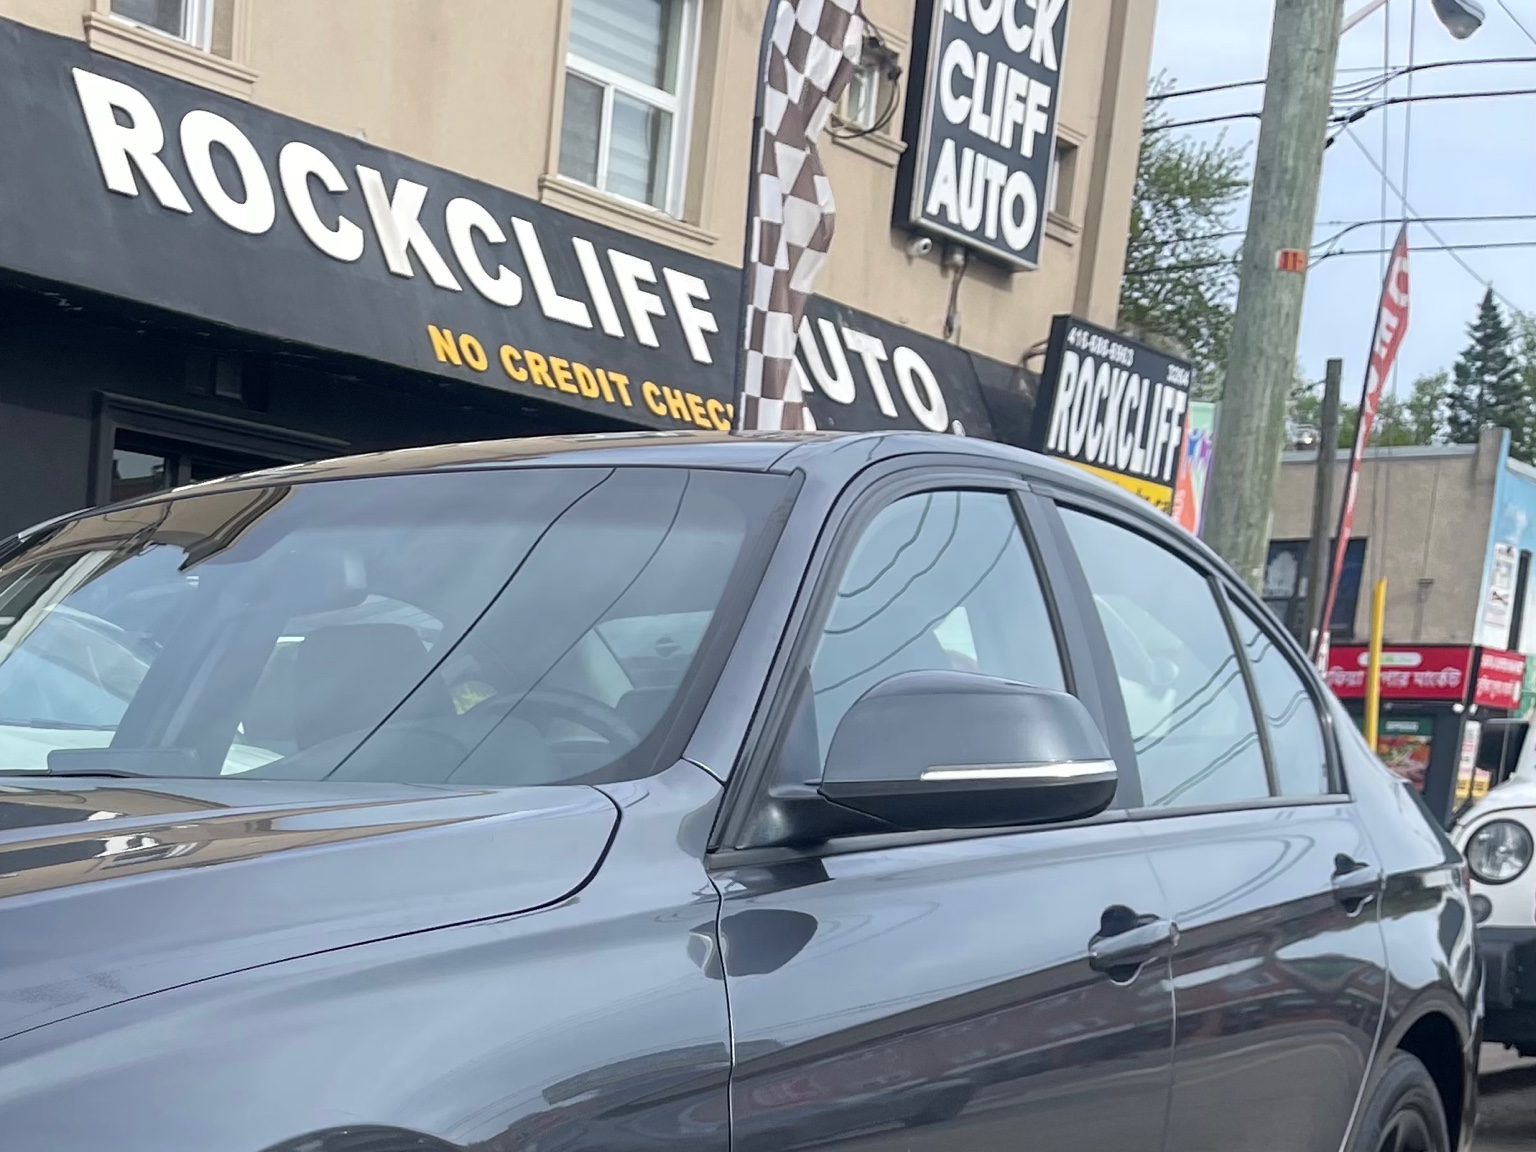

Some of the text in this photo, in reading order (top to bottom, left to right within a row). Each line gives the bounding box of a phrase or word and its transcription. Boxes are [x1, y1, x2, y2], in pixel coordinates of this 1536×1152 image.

[943, 0, 1064, 71] CK
[939, 38, 1051, 158] CLIFF
[71, 67, 949, 434] ROCKCLIFF UTO
[925, 138, 1038, 251] AUTO
[427, 324, 734, 431] NO CREDIT CHEC
[1047, 350, 1188, 482] ROCKCLIFF
